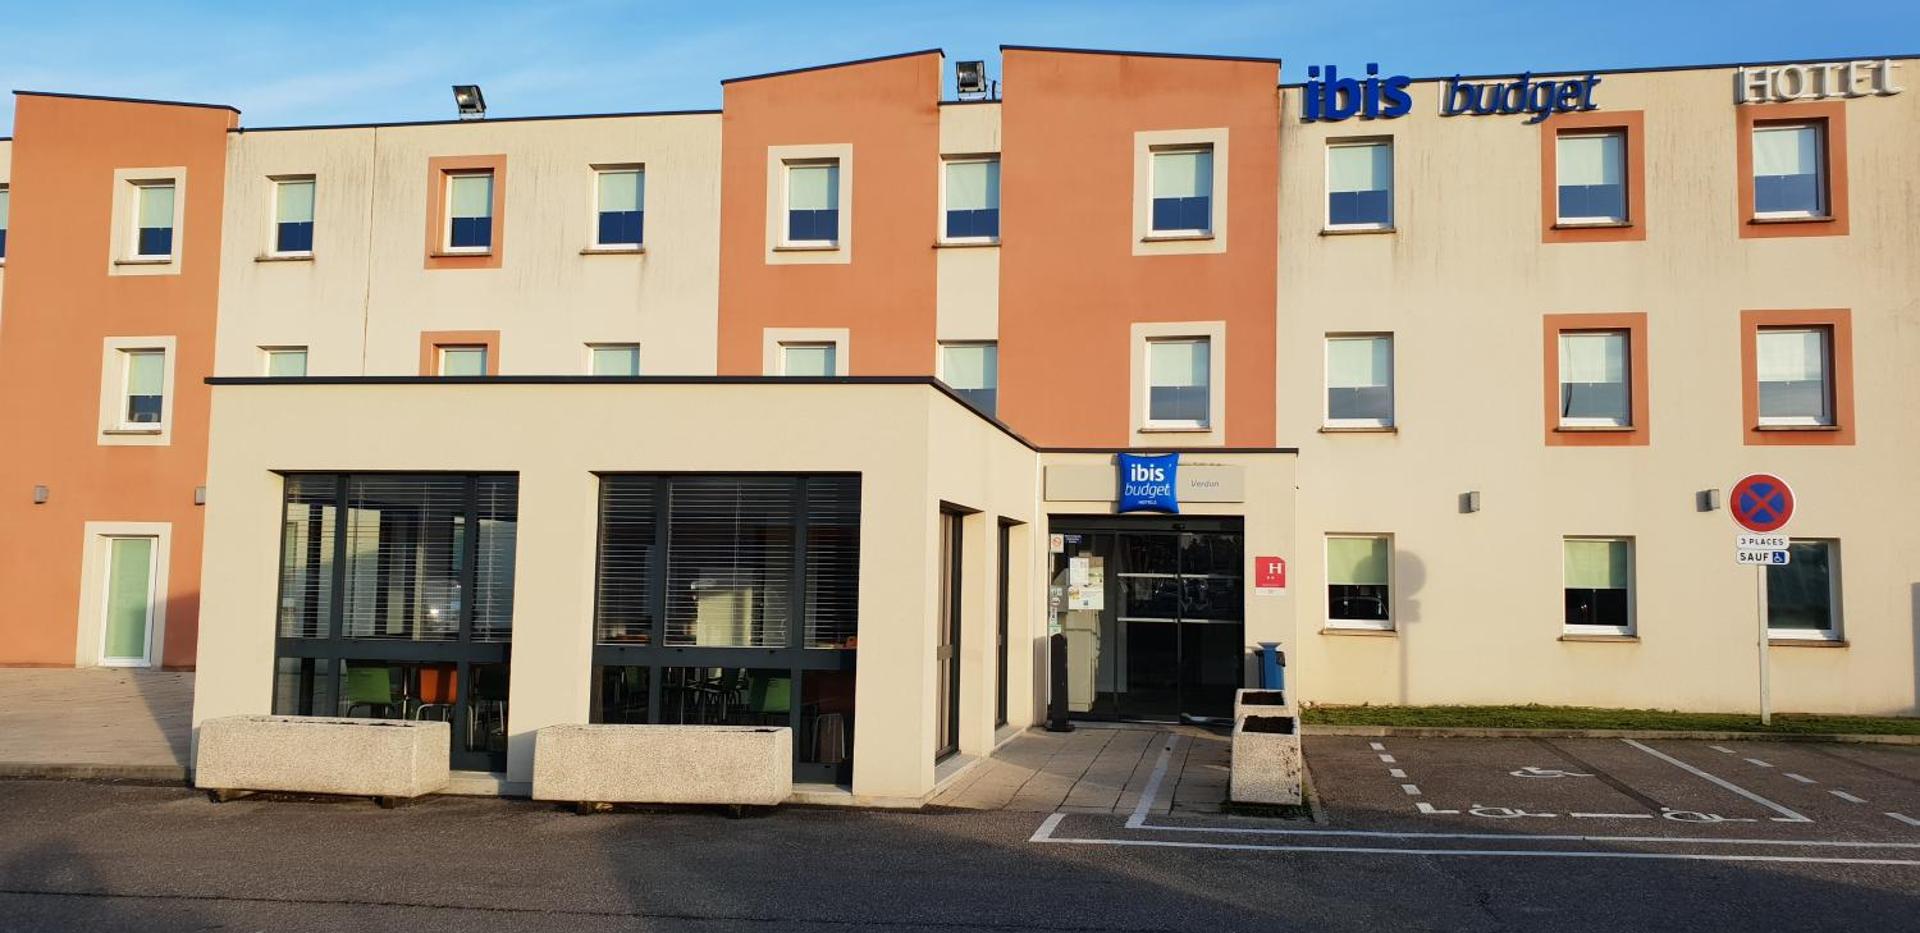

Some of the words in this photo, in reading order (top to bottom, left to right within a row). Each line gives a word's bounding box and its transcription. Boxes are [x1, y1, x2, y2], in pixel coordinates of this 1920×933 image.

[1306, 63, 1413, 120] ibis
[1446, 71, 1602, 124] budget
[1738, 58, 1905, 102] HOTEL
[1131, 464, 1165, 482] ibis
[1124, 483, 1171, 499] budget
[1749, 538, 1784, 546] PLACES
[1740, 552, 1769, 561] SAUF
[1269, 562, 1282, 575] H
